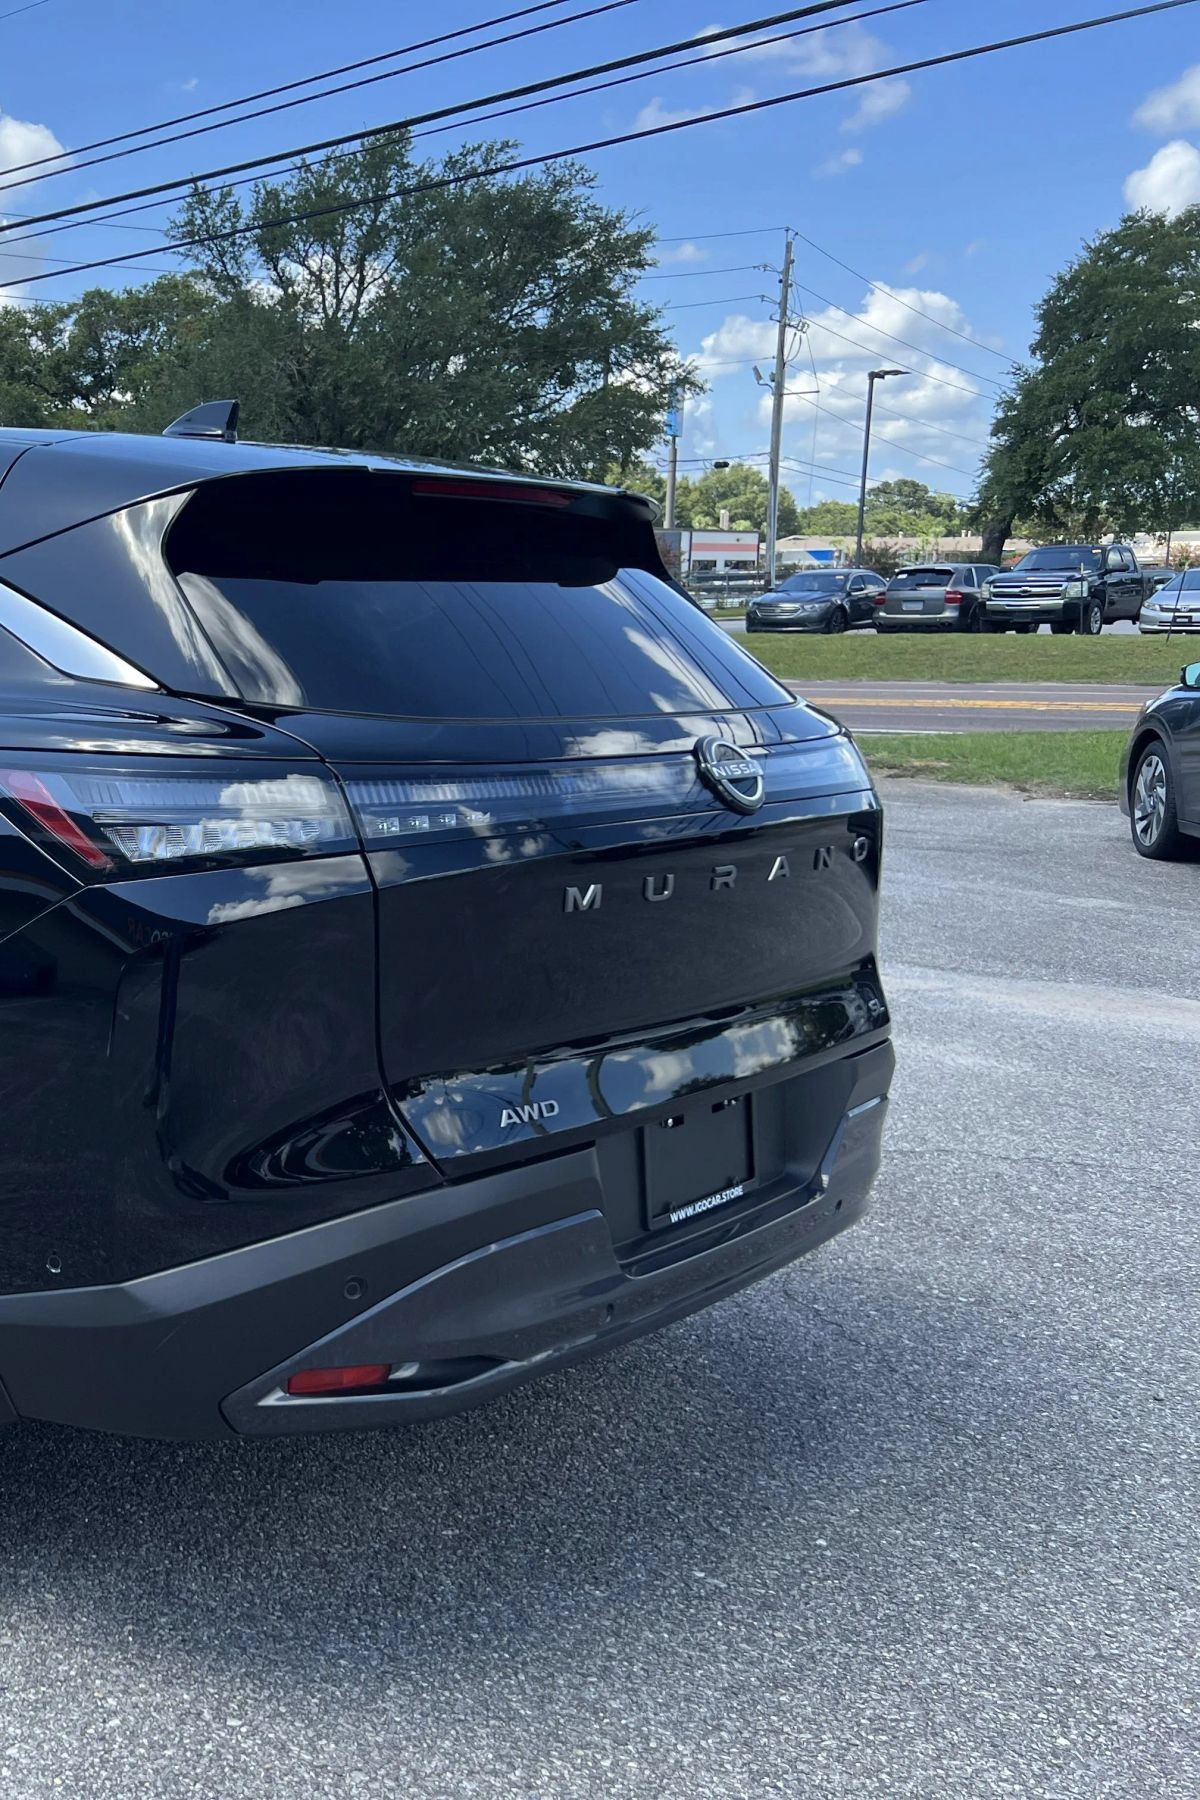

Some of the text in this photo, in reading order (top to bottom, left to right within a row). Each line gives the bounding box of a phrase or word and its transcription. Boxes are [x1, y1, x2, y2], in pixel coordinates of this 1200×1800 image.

[711, 763, 759, 778] NISSA
[563, 836, 869, 912] MURANO
[500, 1100, 560, 1128] AWD
[670, 1185, 744, 1223] WWW.IGOCAR.STORE
